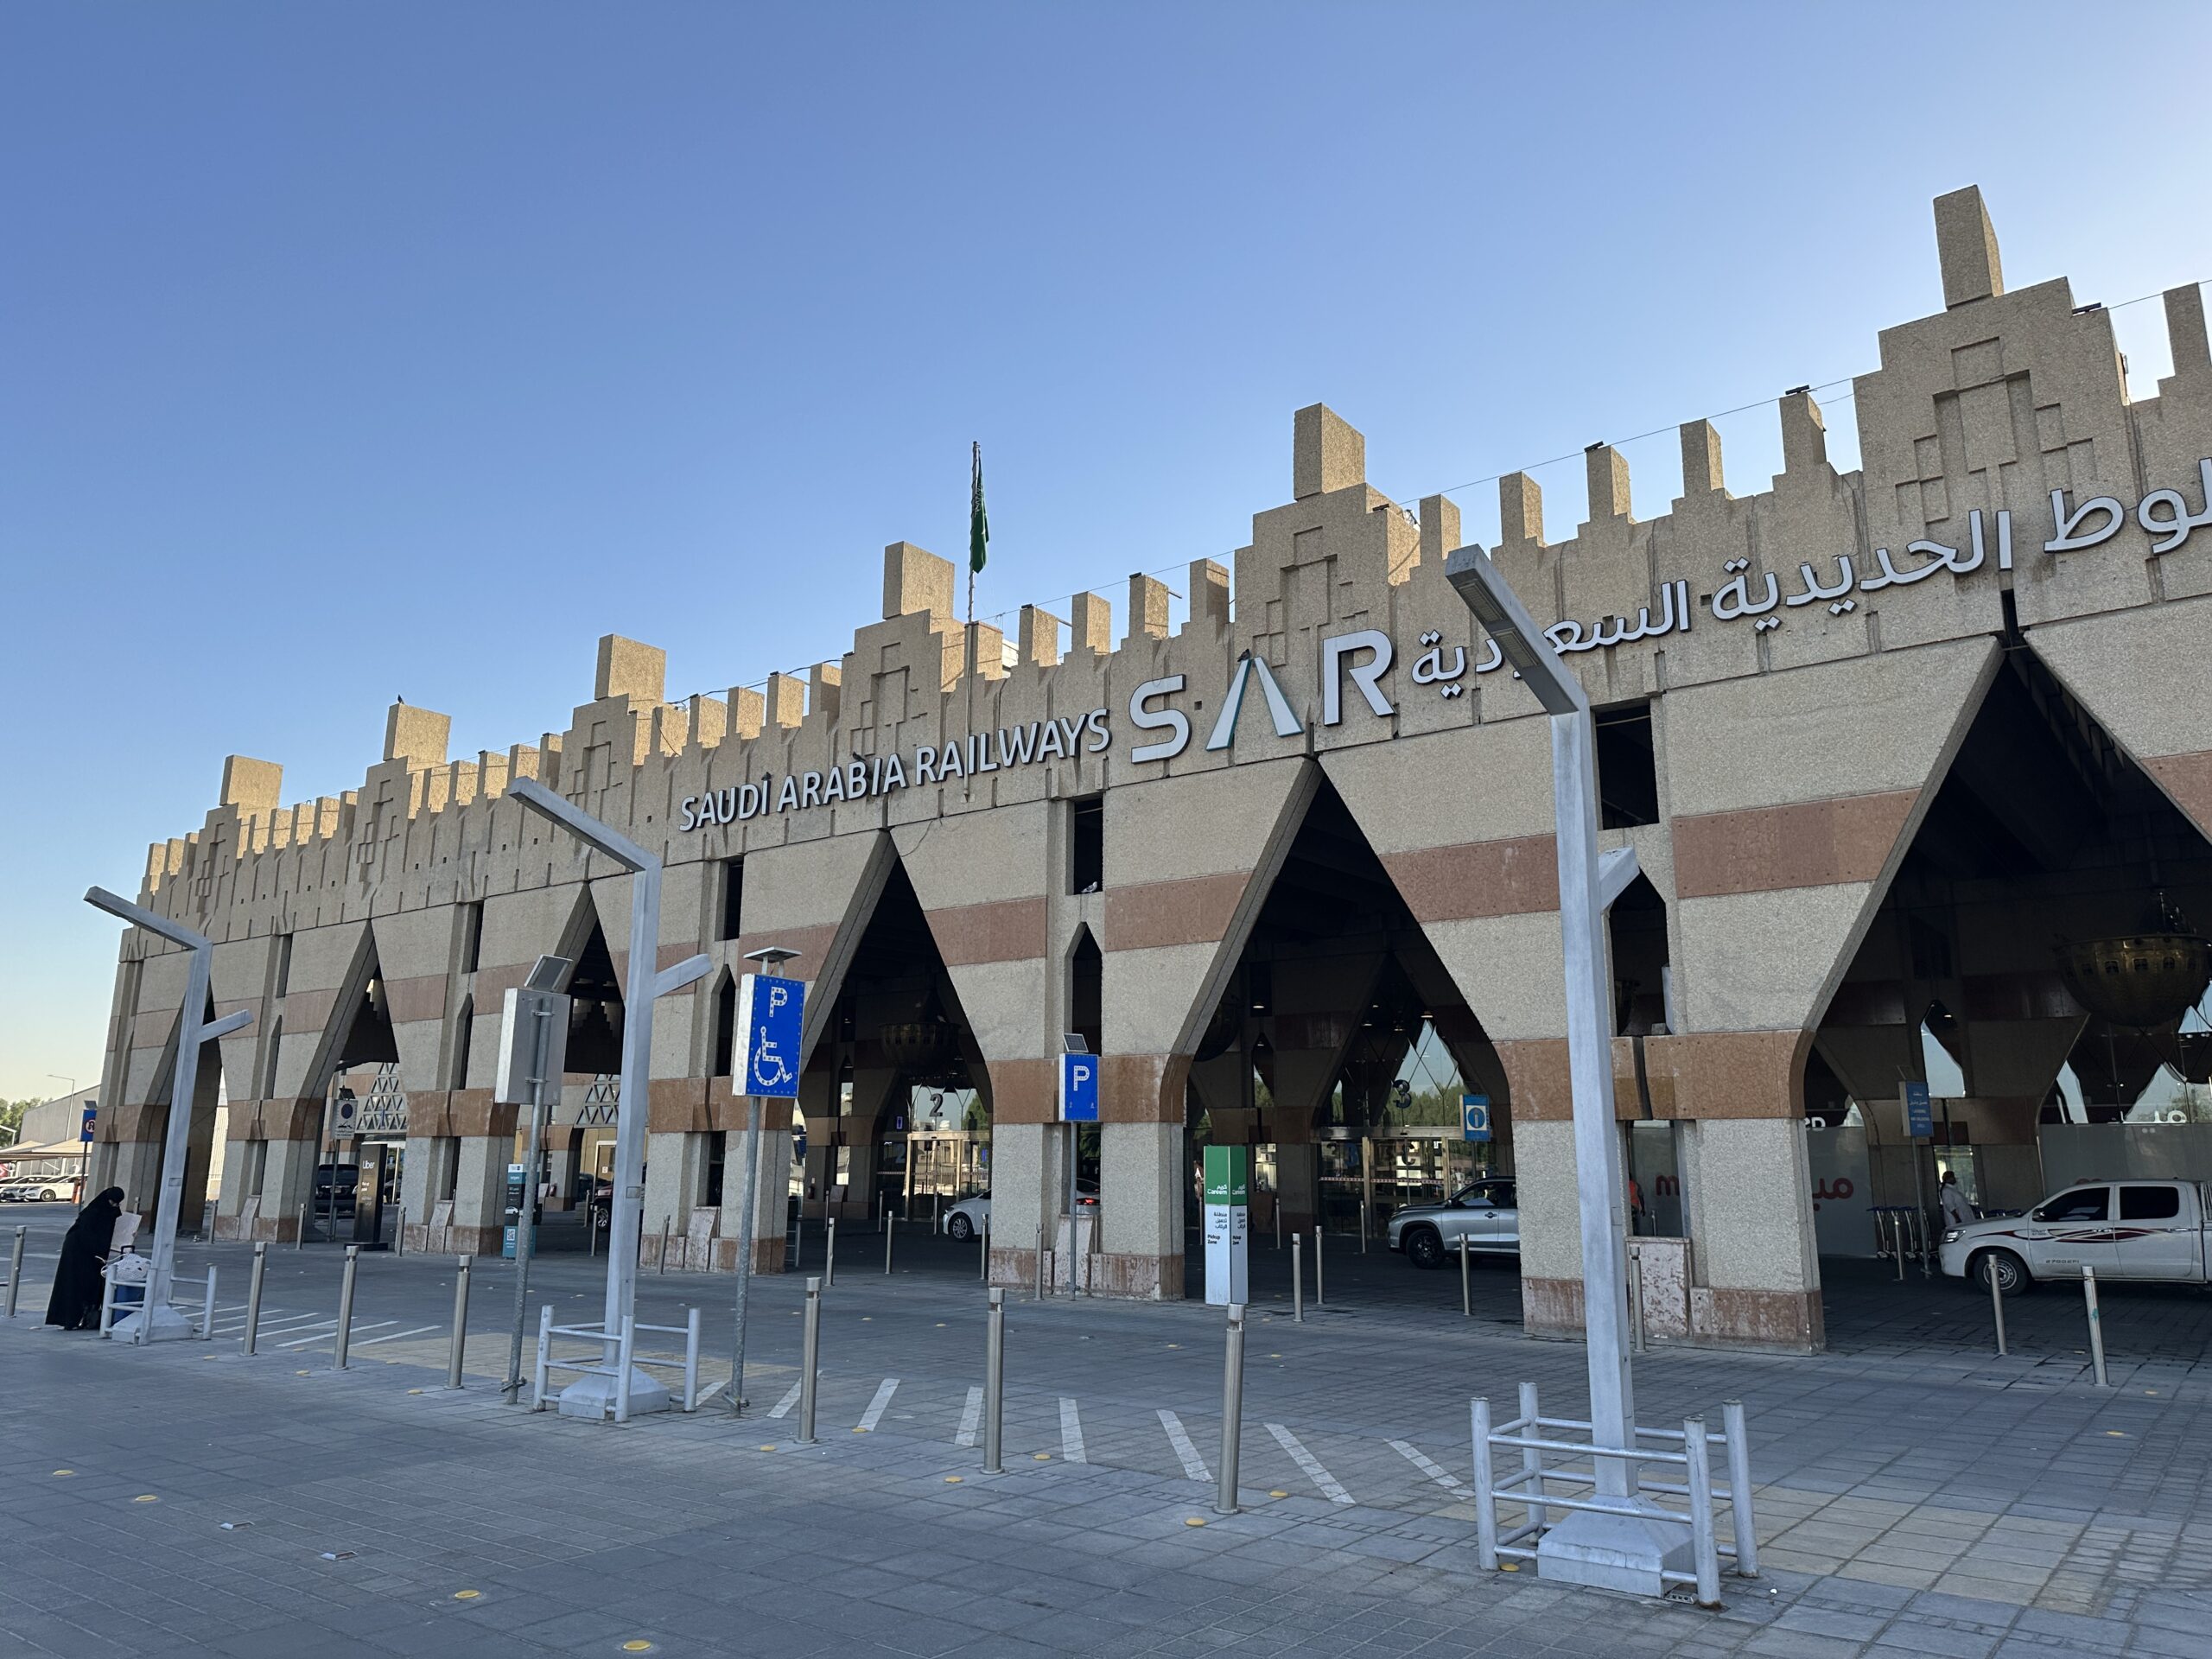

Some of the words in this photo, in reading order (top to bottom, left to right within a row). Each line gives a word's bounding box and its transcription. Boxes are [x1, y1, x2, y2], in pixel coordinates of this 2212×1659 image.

[1711, 508, 2013, 632] الحديدية
[1410, 578, 1691, 700] السعدية
[679, 779, 771, 832] SAUDI
[778, 753, 910, 814] ARABIA
[915, 708, 1112, 787] RAILWAYS
[769, 986, 788, 1018] P
[1073, 1065, 1090, 1091] P
[929, 1093, 944, 1117] 2
[1393, 1079, 1412, 1109] 3
[362, 1160, 375, 1170] Uber
